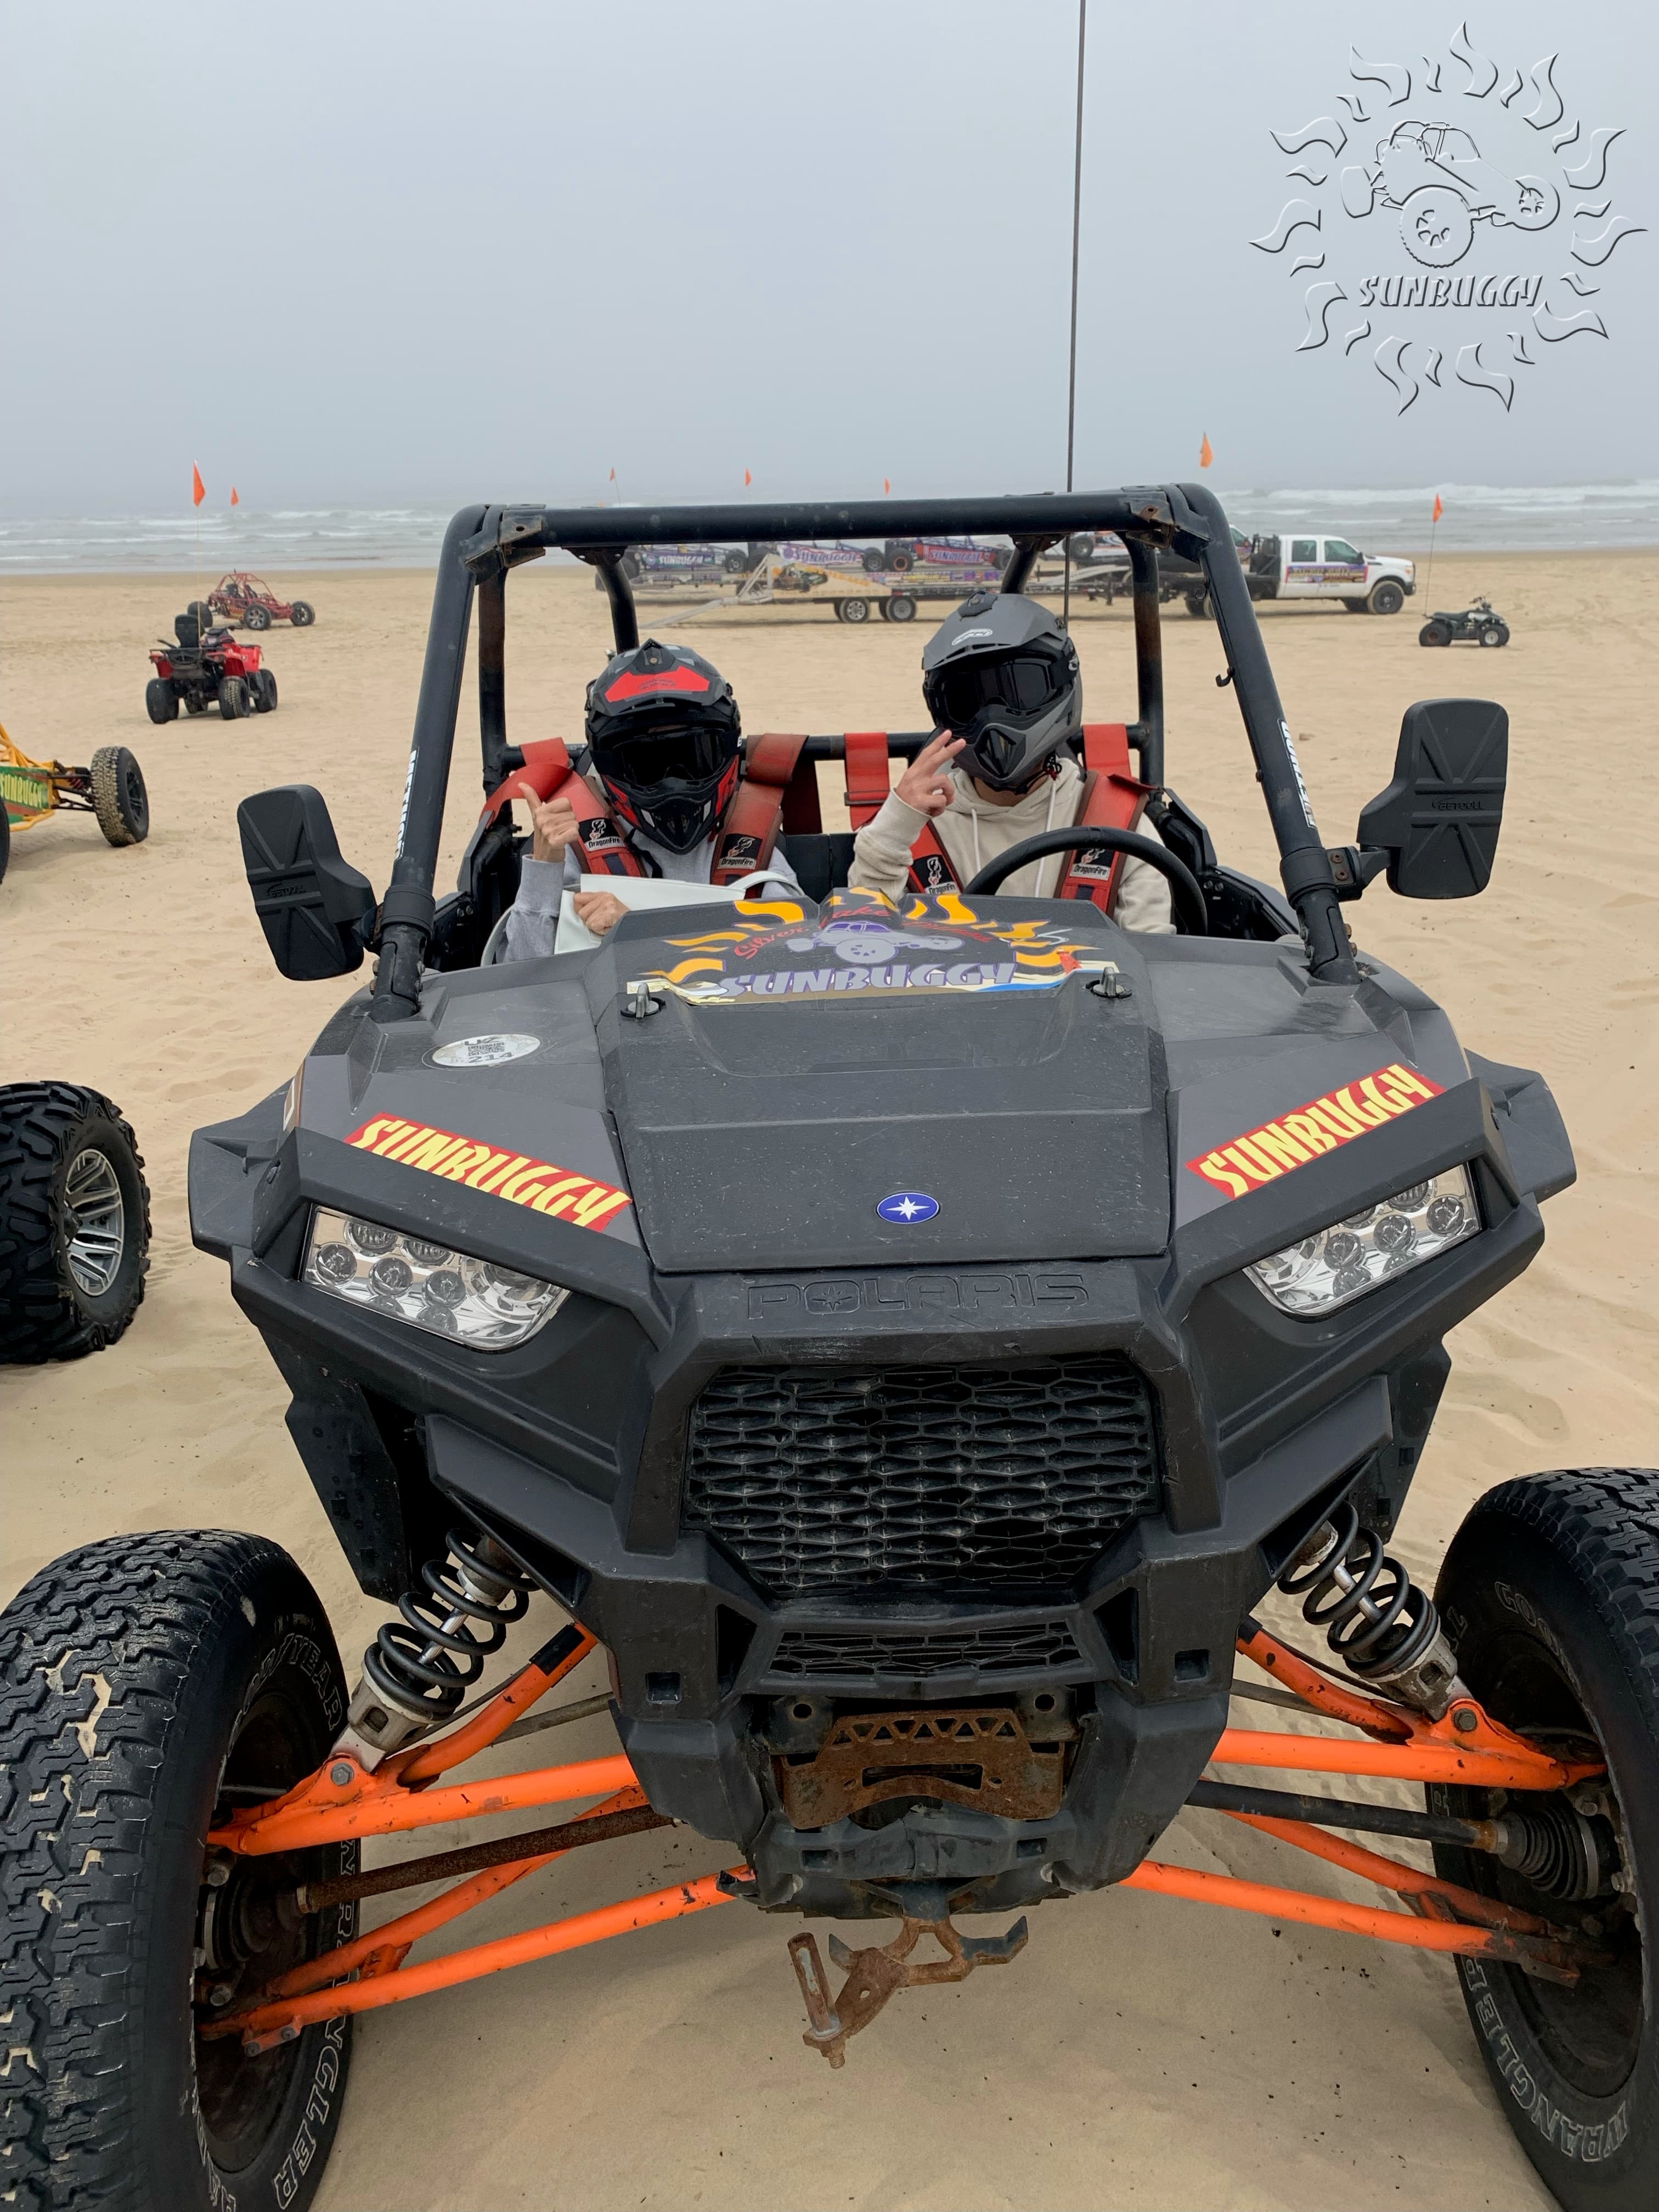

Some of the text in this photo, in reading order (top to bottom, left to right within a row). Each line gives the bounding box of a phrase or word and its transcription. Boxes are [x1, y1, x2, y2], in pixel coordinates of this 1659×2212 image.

[0, 773, 42, 809] SUNBUGGY
[589, 837, 621, 847] DragonFire
[721, 858, 754, 867] DragonFire
[1075, 865, 1107, 876] DragonFire
[735, 927, 809, 960] Silver
[719, 963, 1017, 997] SUNBUGGY
[469, 1051, 513, 1063] 214
[1199, 1064, 1435, 1198] SUNBUGGY
[351, 1119, 630, 1227] SUNBUGGY
[747, 1274, 1089, 1319] POLARIS
[1461, 1954, 1628, 2162] WRANGLER
